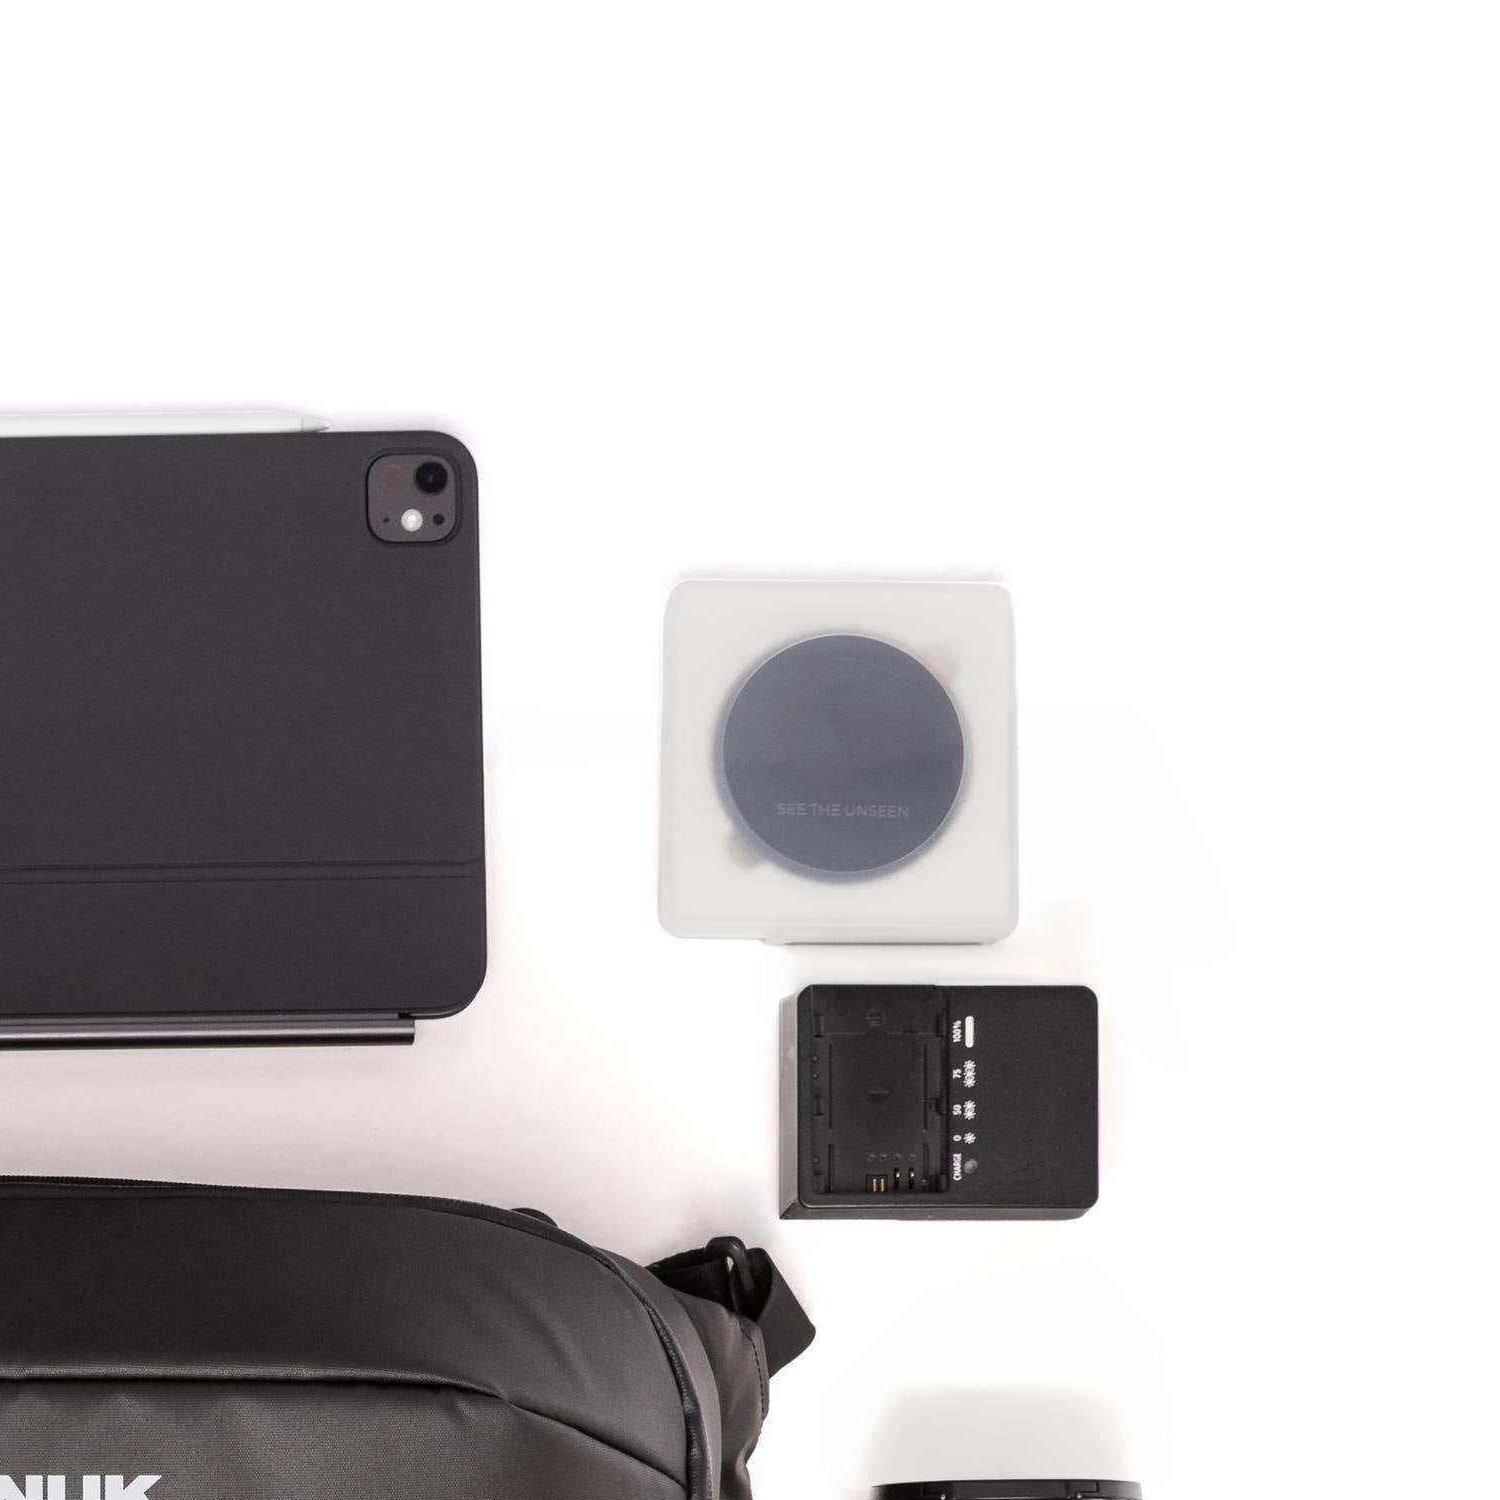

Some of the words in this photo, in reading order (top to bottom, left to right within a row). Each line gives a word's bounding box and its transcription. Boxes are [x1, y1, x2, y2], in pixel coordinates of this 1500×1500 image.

[777, 802, 806, 816] SEE
[810, 803, 840, 817] THE
[844, 803, 909, 818] UNSEEN
[953, 1020, 962, 1043] 100%
[953, 1068, 962, 1079] 75
[953, 1104, 962, 1116] 50
[953, 1153, 962, 1181] CHARGE
